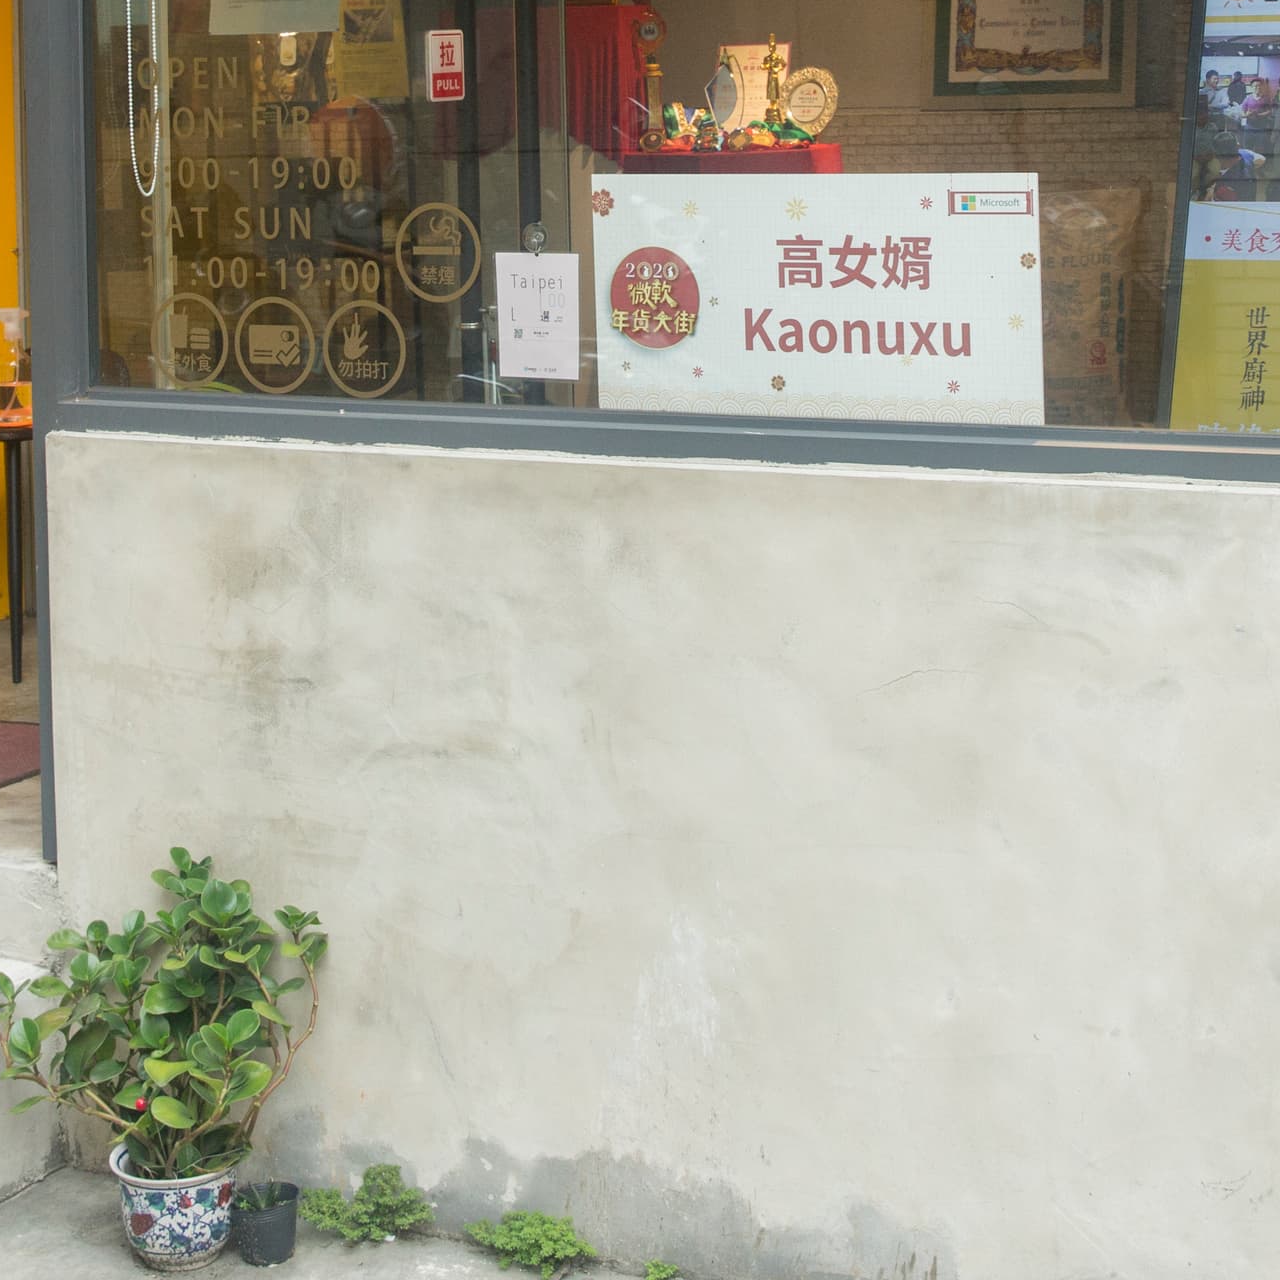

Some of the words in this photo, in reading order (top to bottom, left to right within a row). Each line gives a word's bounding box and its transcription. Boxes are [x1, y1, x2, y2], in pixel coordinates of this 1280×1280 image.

[439, 41, 456, 67] 拉
[137, 56, 238, 90] OPEN
[436, 79, 460, 91] PULL
[979, 198, 1020, 207] Microsoft
[141, 206, 209, 239] SAT
[234, 206, 312, 240] SUN
[420, 265, 456, 286] 禁煙
[625, 261, 680, 280] 2020
[775, 234, 933, 291] 高女婿
[510, 273, 564, 297] Taipei
[627, 279, 679, 310] 微軟
[611, 308, 697, 335] 年貨大街
[743, 307, 972, 357] Kaonuxu
[338, 358, 389, 380] 勿拍打
[1239, 306, 1271, 412] 世界廚神
